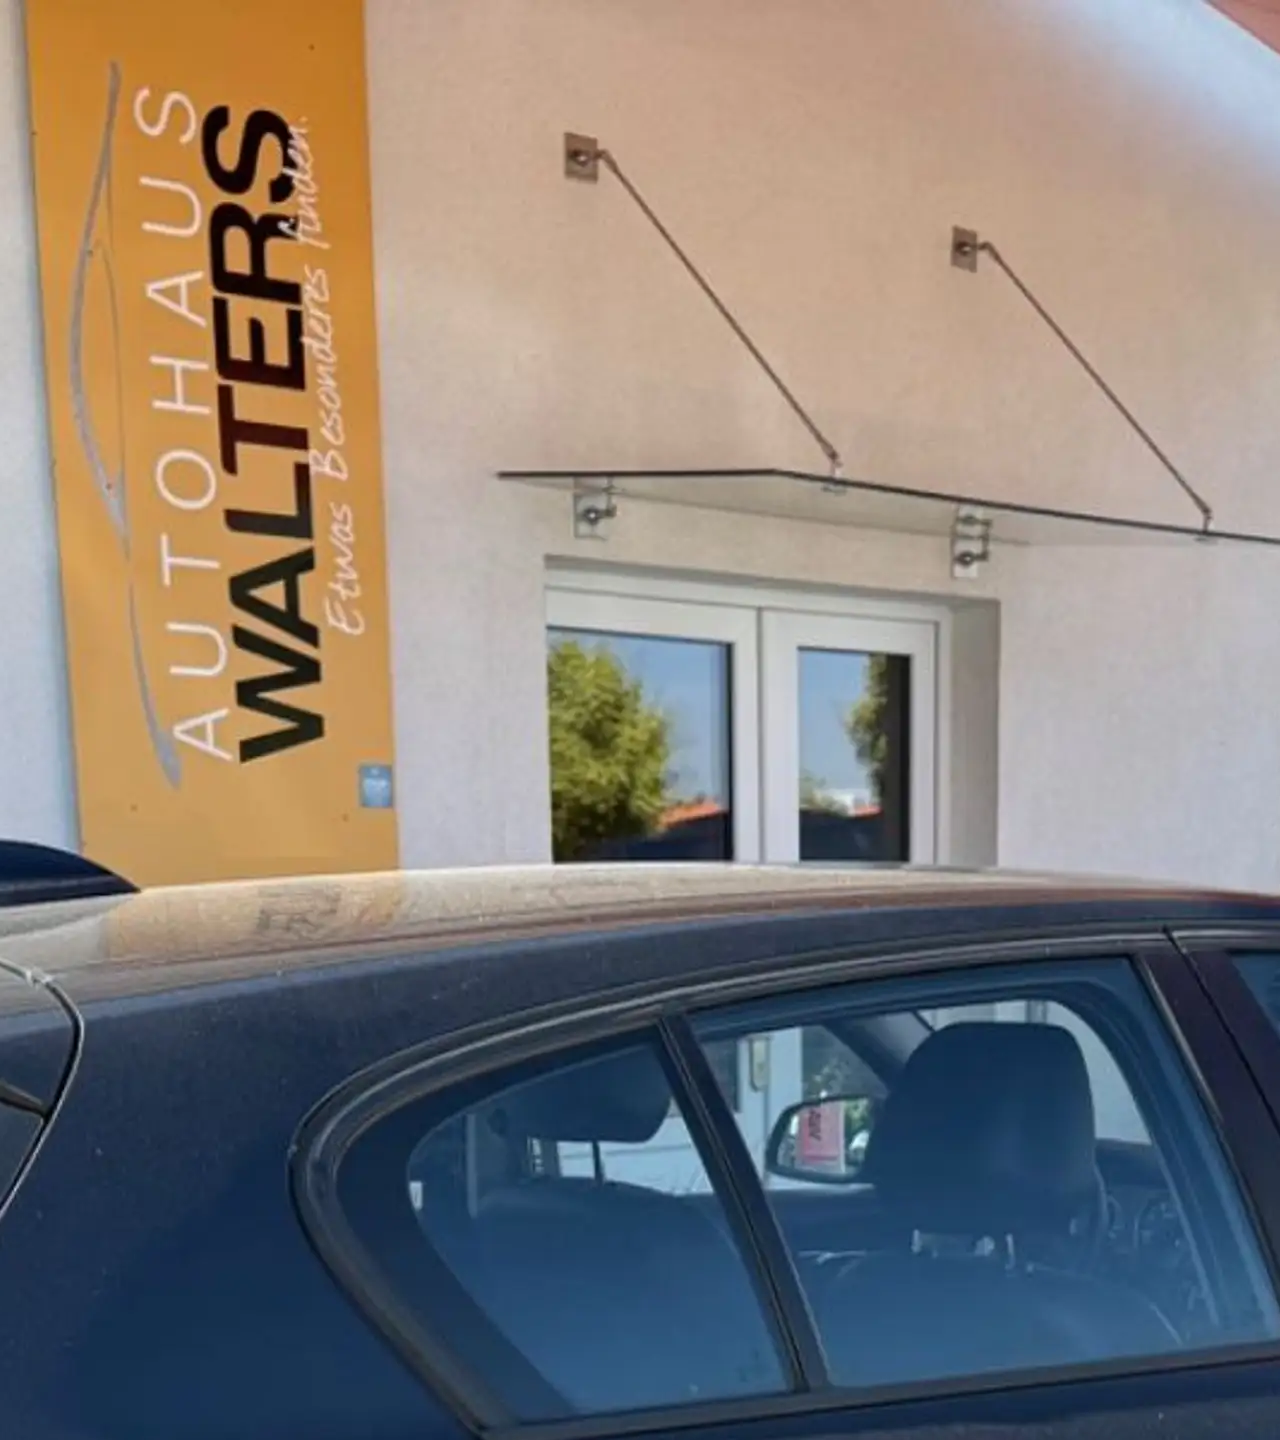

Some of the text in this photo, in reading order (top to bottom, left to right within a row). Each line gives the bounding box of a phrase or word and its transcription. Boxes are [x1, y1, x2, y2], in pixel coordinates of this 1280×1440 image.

[133, 86, 233, 763] AUTOHAUS
[201, 105, 325, 764] WALTERS
[297, 264, 349, 482] Besonderes
[327, 501, 365, 637] Etwas
